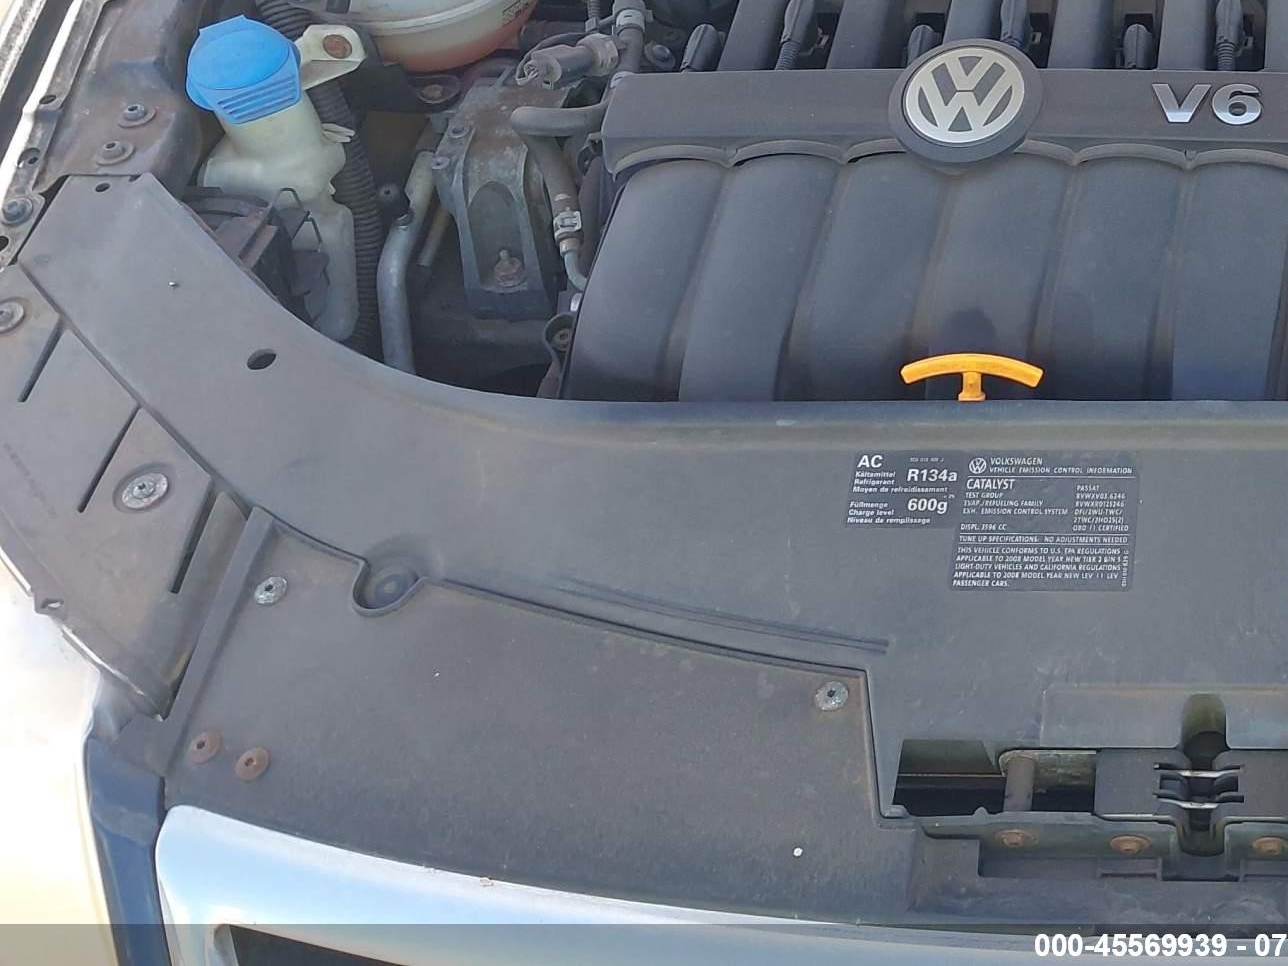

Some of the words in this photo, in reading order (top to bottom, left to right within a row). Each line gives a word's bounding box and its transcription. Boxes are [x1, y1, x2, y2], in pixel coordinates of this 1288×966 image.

[1152, 84, 1262, 125] V6
[857, 455, 883, 468] AC
[907, 469, 958, 482] R134a
[967, 478, 1015, 489] CATALYST
[908, 498, 948, 514] 600g
